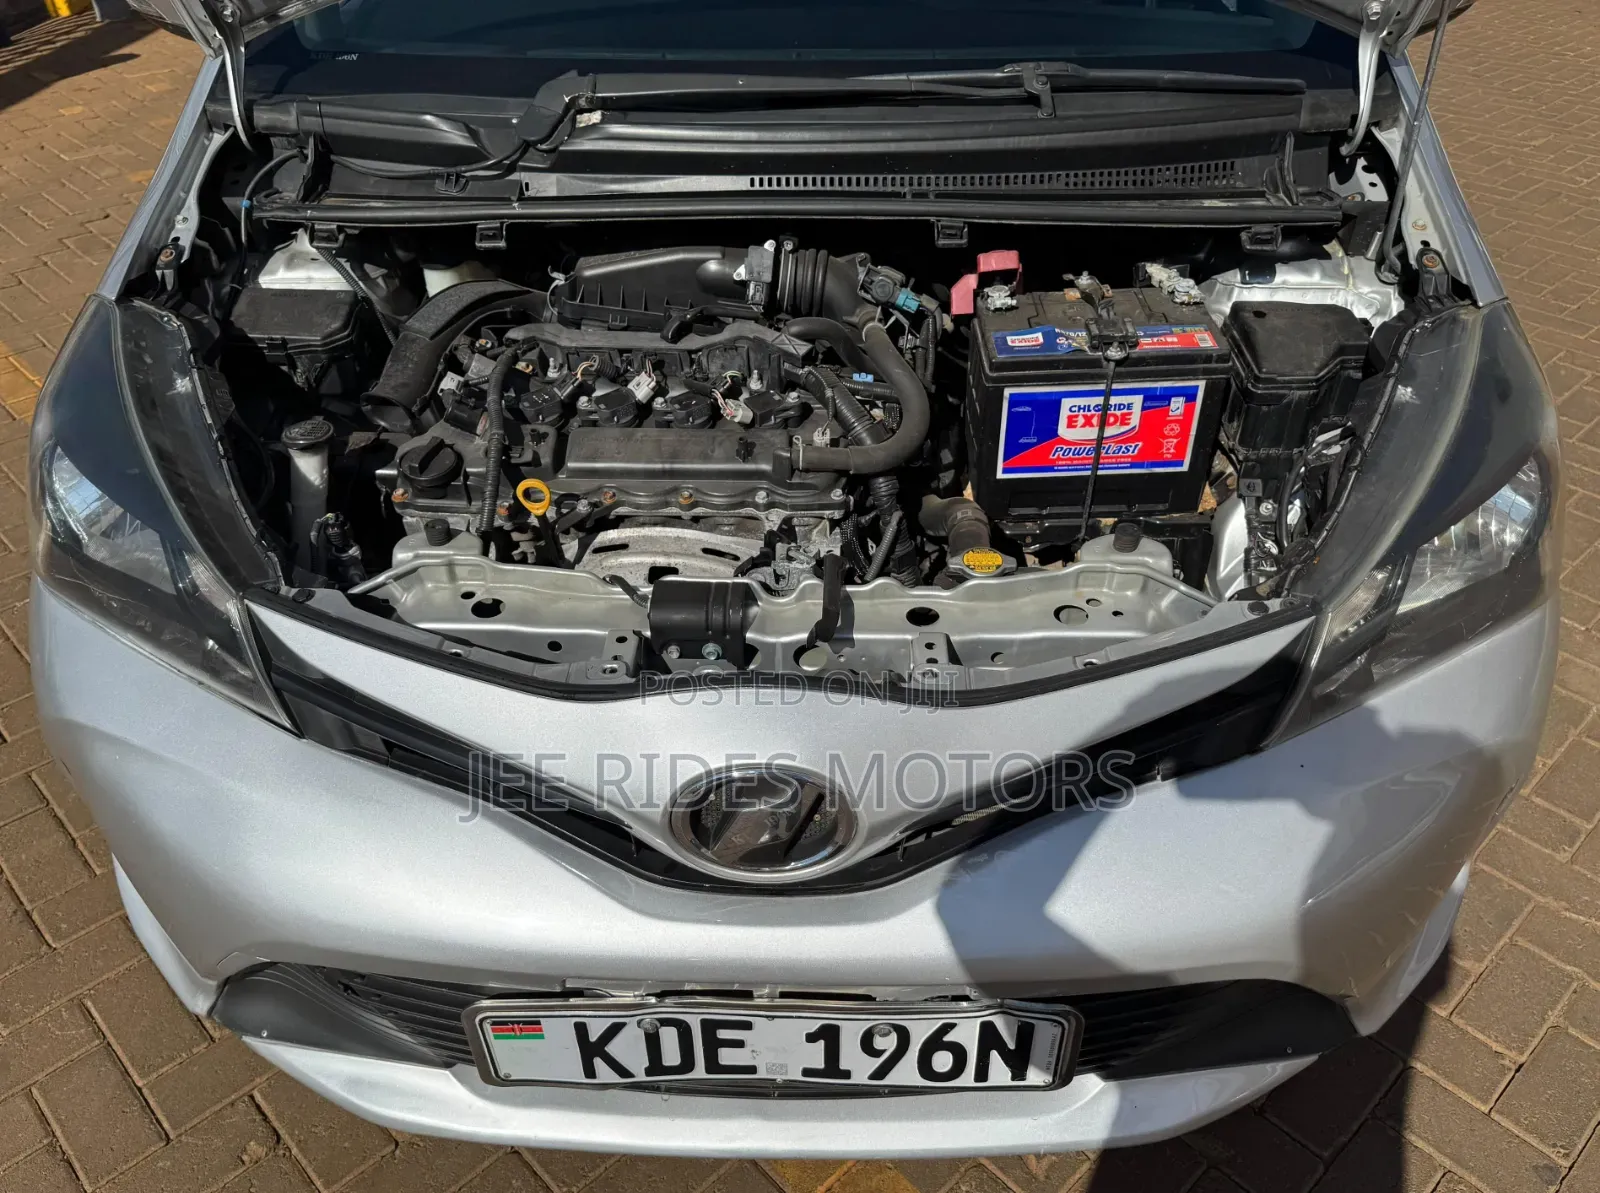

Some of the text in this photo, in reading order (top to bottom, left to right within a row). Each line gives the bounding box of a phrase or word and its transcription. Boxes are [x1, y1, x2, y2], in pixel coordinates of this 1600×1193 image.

[1069, 402, 1134, 413] CHLORIDE
[1066, 411, 1134, 429] EXIDE
[573, 1017, 758, 1080] KDE
[801, 1019, 1035, 1083] 196N
